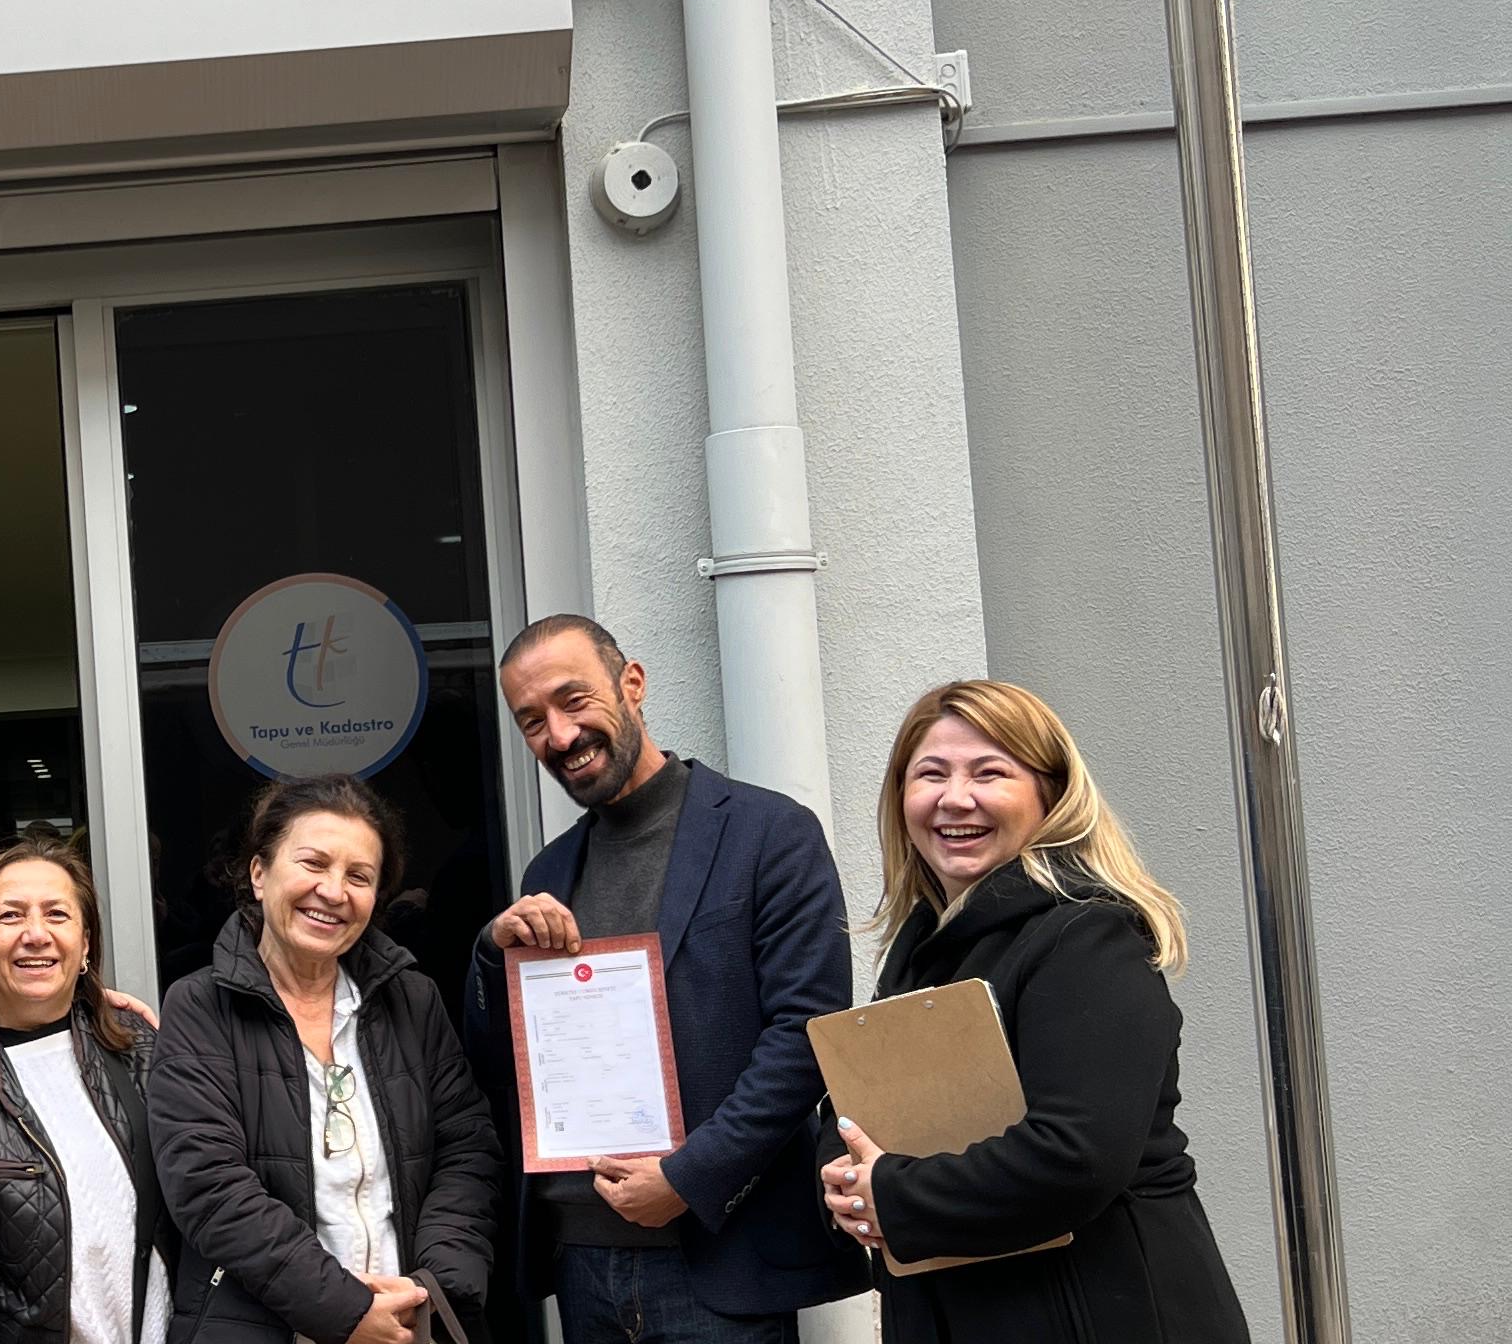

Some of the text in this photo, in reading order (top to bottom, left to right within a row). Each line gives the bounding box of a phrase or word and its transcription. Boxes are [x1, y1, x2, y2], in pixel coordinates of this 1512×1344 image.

[249, 718, 394, 741] Tapu ve Kadastro
